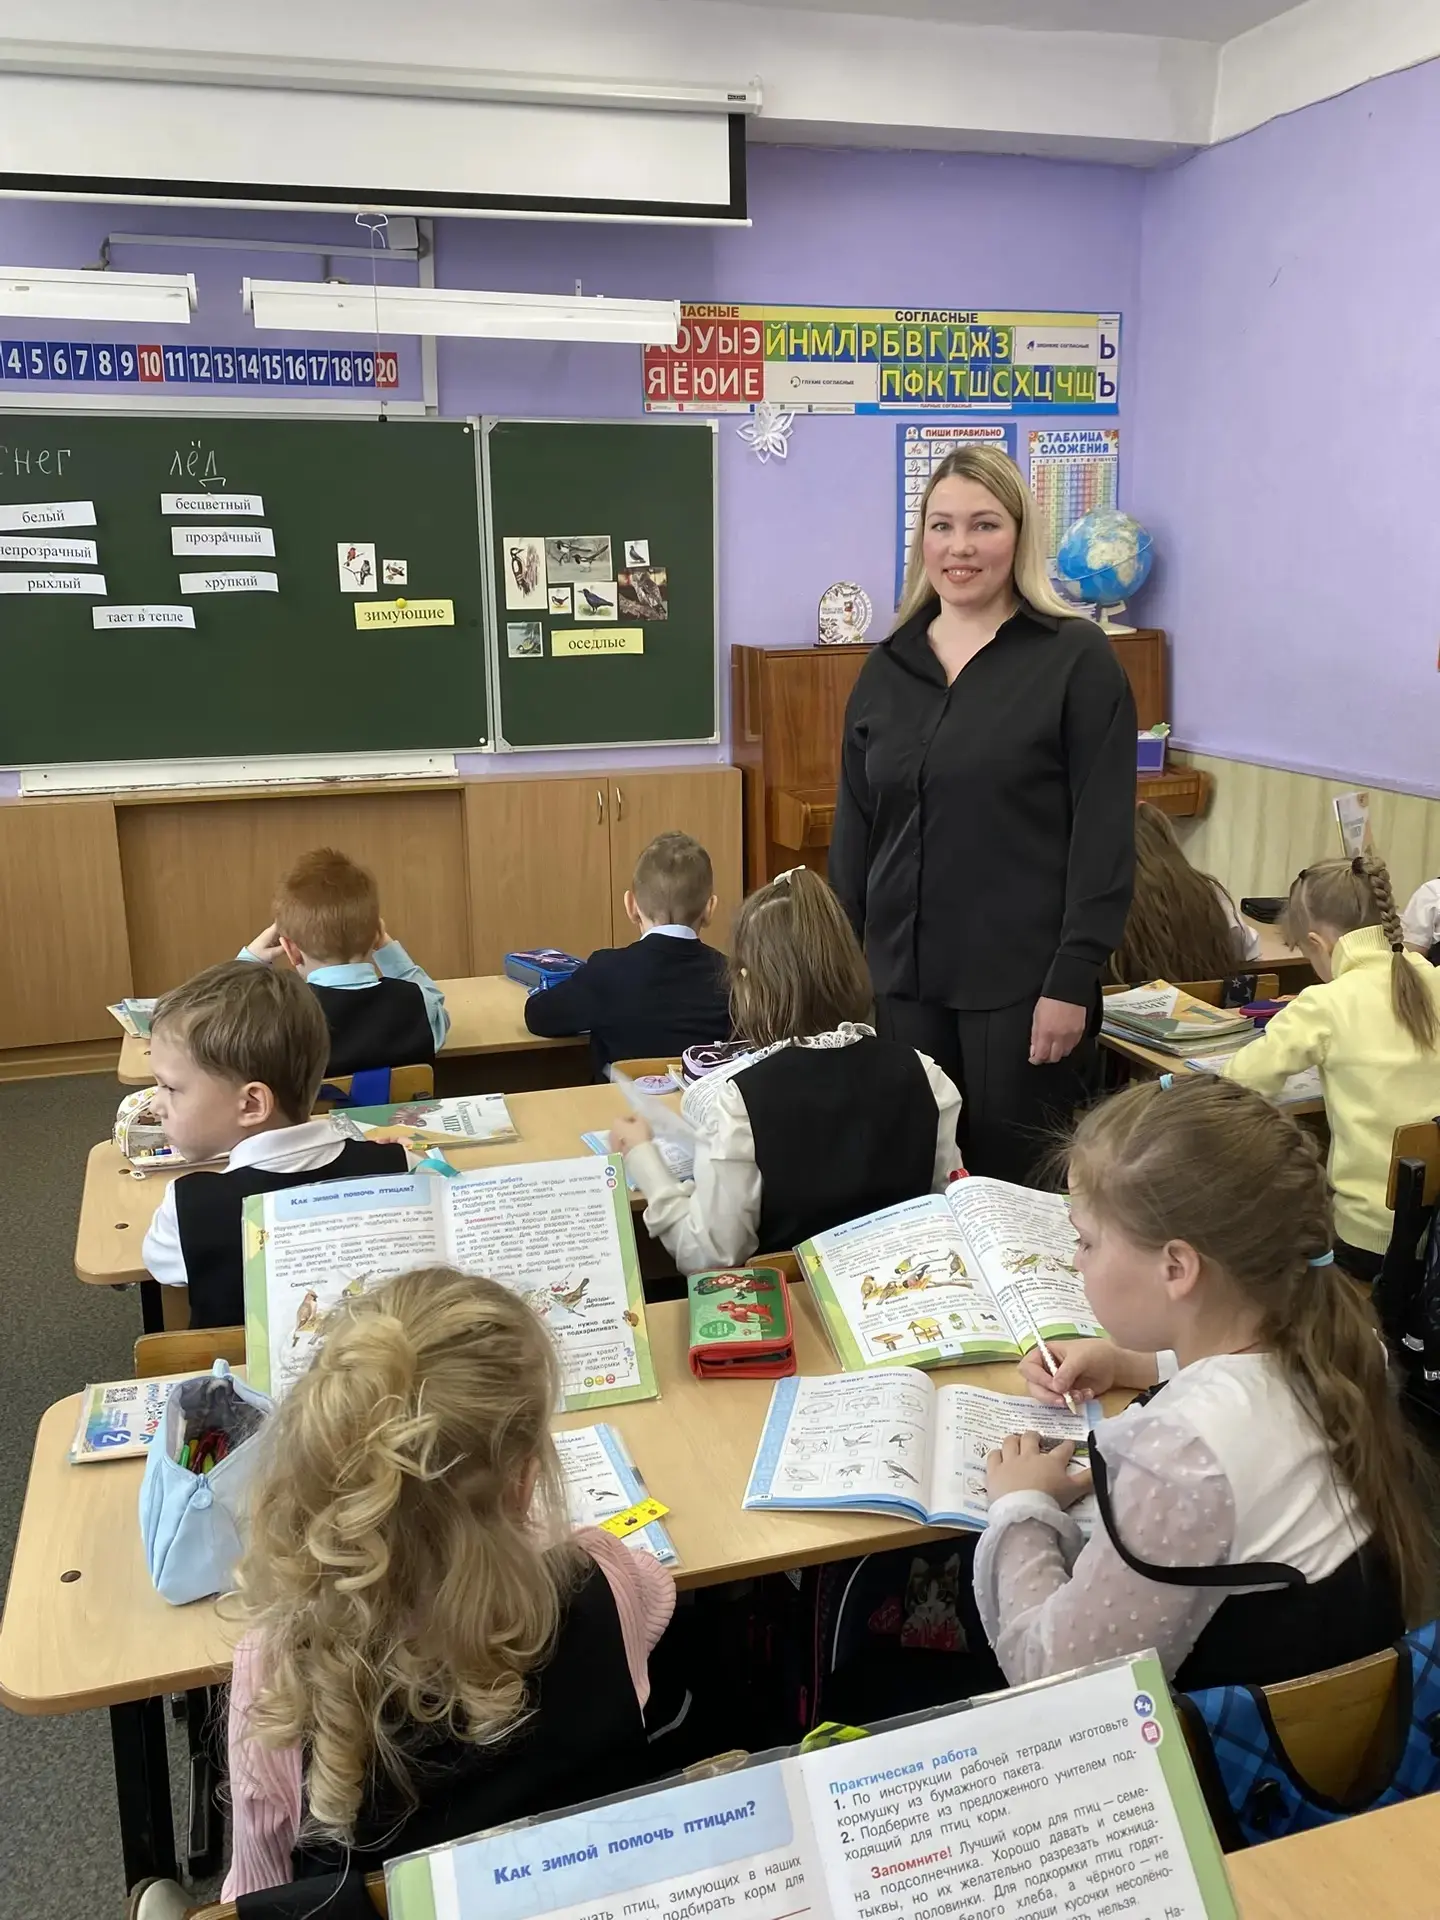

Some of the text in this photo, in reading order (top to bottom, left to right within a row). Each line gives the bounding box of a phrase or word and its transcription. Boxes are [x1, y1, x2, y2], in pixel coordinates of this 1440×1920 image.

[680, 305, 740, 318] ЛАСНЫЕ
[895, 310, 978, 324] СОГЛАСНЫЕ
[7, 348, 397, 382] 4 5 6 7 8 9 10 11 12 13 14 15 16 17 18 19 20
[953, 428, 1002, 436] ПРАВИЛЬНО
[1046, 432, 1104, 443] ТАБЛИЦА
[1040, 443, 1109, 454] СЛОЖЕНИЯ
[176, 497, 251, 512] бесцветный
[22, 510, 65, 524] белый
[185, 531, 262, 546] прозрачный
[28, 576, 82, 592] рыхлый
[204, 575, 258, 590] хрупкий
[106, 612, 184, 624] тает в тепле
[364, 606, 445, 623] зимующие
[568, 635, 626, 651] оседлые
[828, 1746, 978, 1796] Практическая работа
[834, 1716, 1130, 1811] 1. По инструкции рабочей тетради изготовьте
[836, 1760, 1045, 1828] кормушку из бумажного пакета.
[840, 1748, 1138, 1844] 2. Подберите из предложенного учителем под-
[844, 1806, 1011, 1862] ходящий для птиц корм.
[870, 1846, 953, 1880] Запомните!
[959, 1830, 1007, 1855] Лучший
[1012, 1820, 1042, 1838] корм
[1048, 1812, 1069, 1829] для
[1073, 1802, 1102, 1819] птиц
[1116, 1786, 1149, 1804] семе-
[854, 1800, 1155, 1903] на подсолнечника. Хорошо давать и семена
[857, 1820, 1159, 1920] тыквы, но их желательно разрезать ножница-
[914, 1835, 1164, 1920] половинки. Для подкормки птиц годят-
[1016, 1888, 1058, 1910] хлеба,
[1068, 1880, 1076, 1892] а
[1086, 1862, 1136, 1885] чёрного
[1155, 1849, 1170, 1862] не
[622, 1896, 661, 1918] птиц,
[668, 1874, 741, 1904] зимующих
[748, 1869, 758, 1881] в
[764, 1855, 802, 1876] наших
[662, 1871, 805, 1920] подбирать корм для
[1064, 1887, 1110, 1912] кусочки
[1116, 1866, 1174, 1894] несолёно-
[1097, 1896, 1140, 1918] нельзя.
[1164, 1905, 1186, 1920] На-
